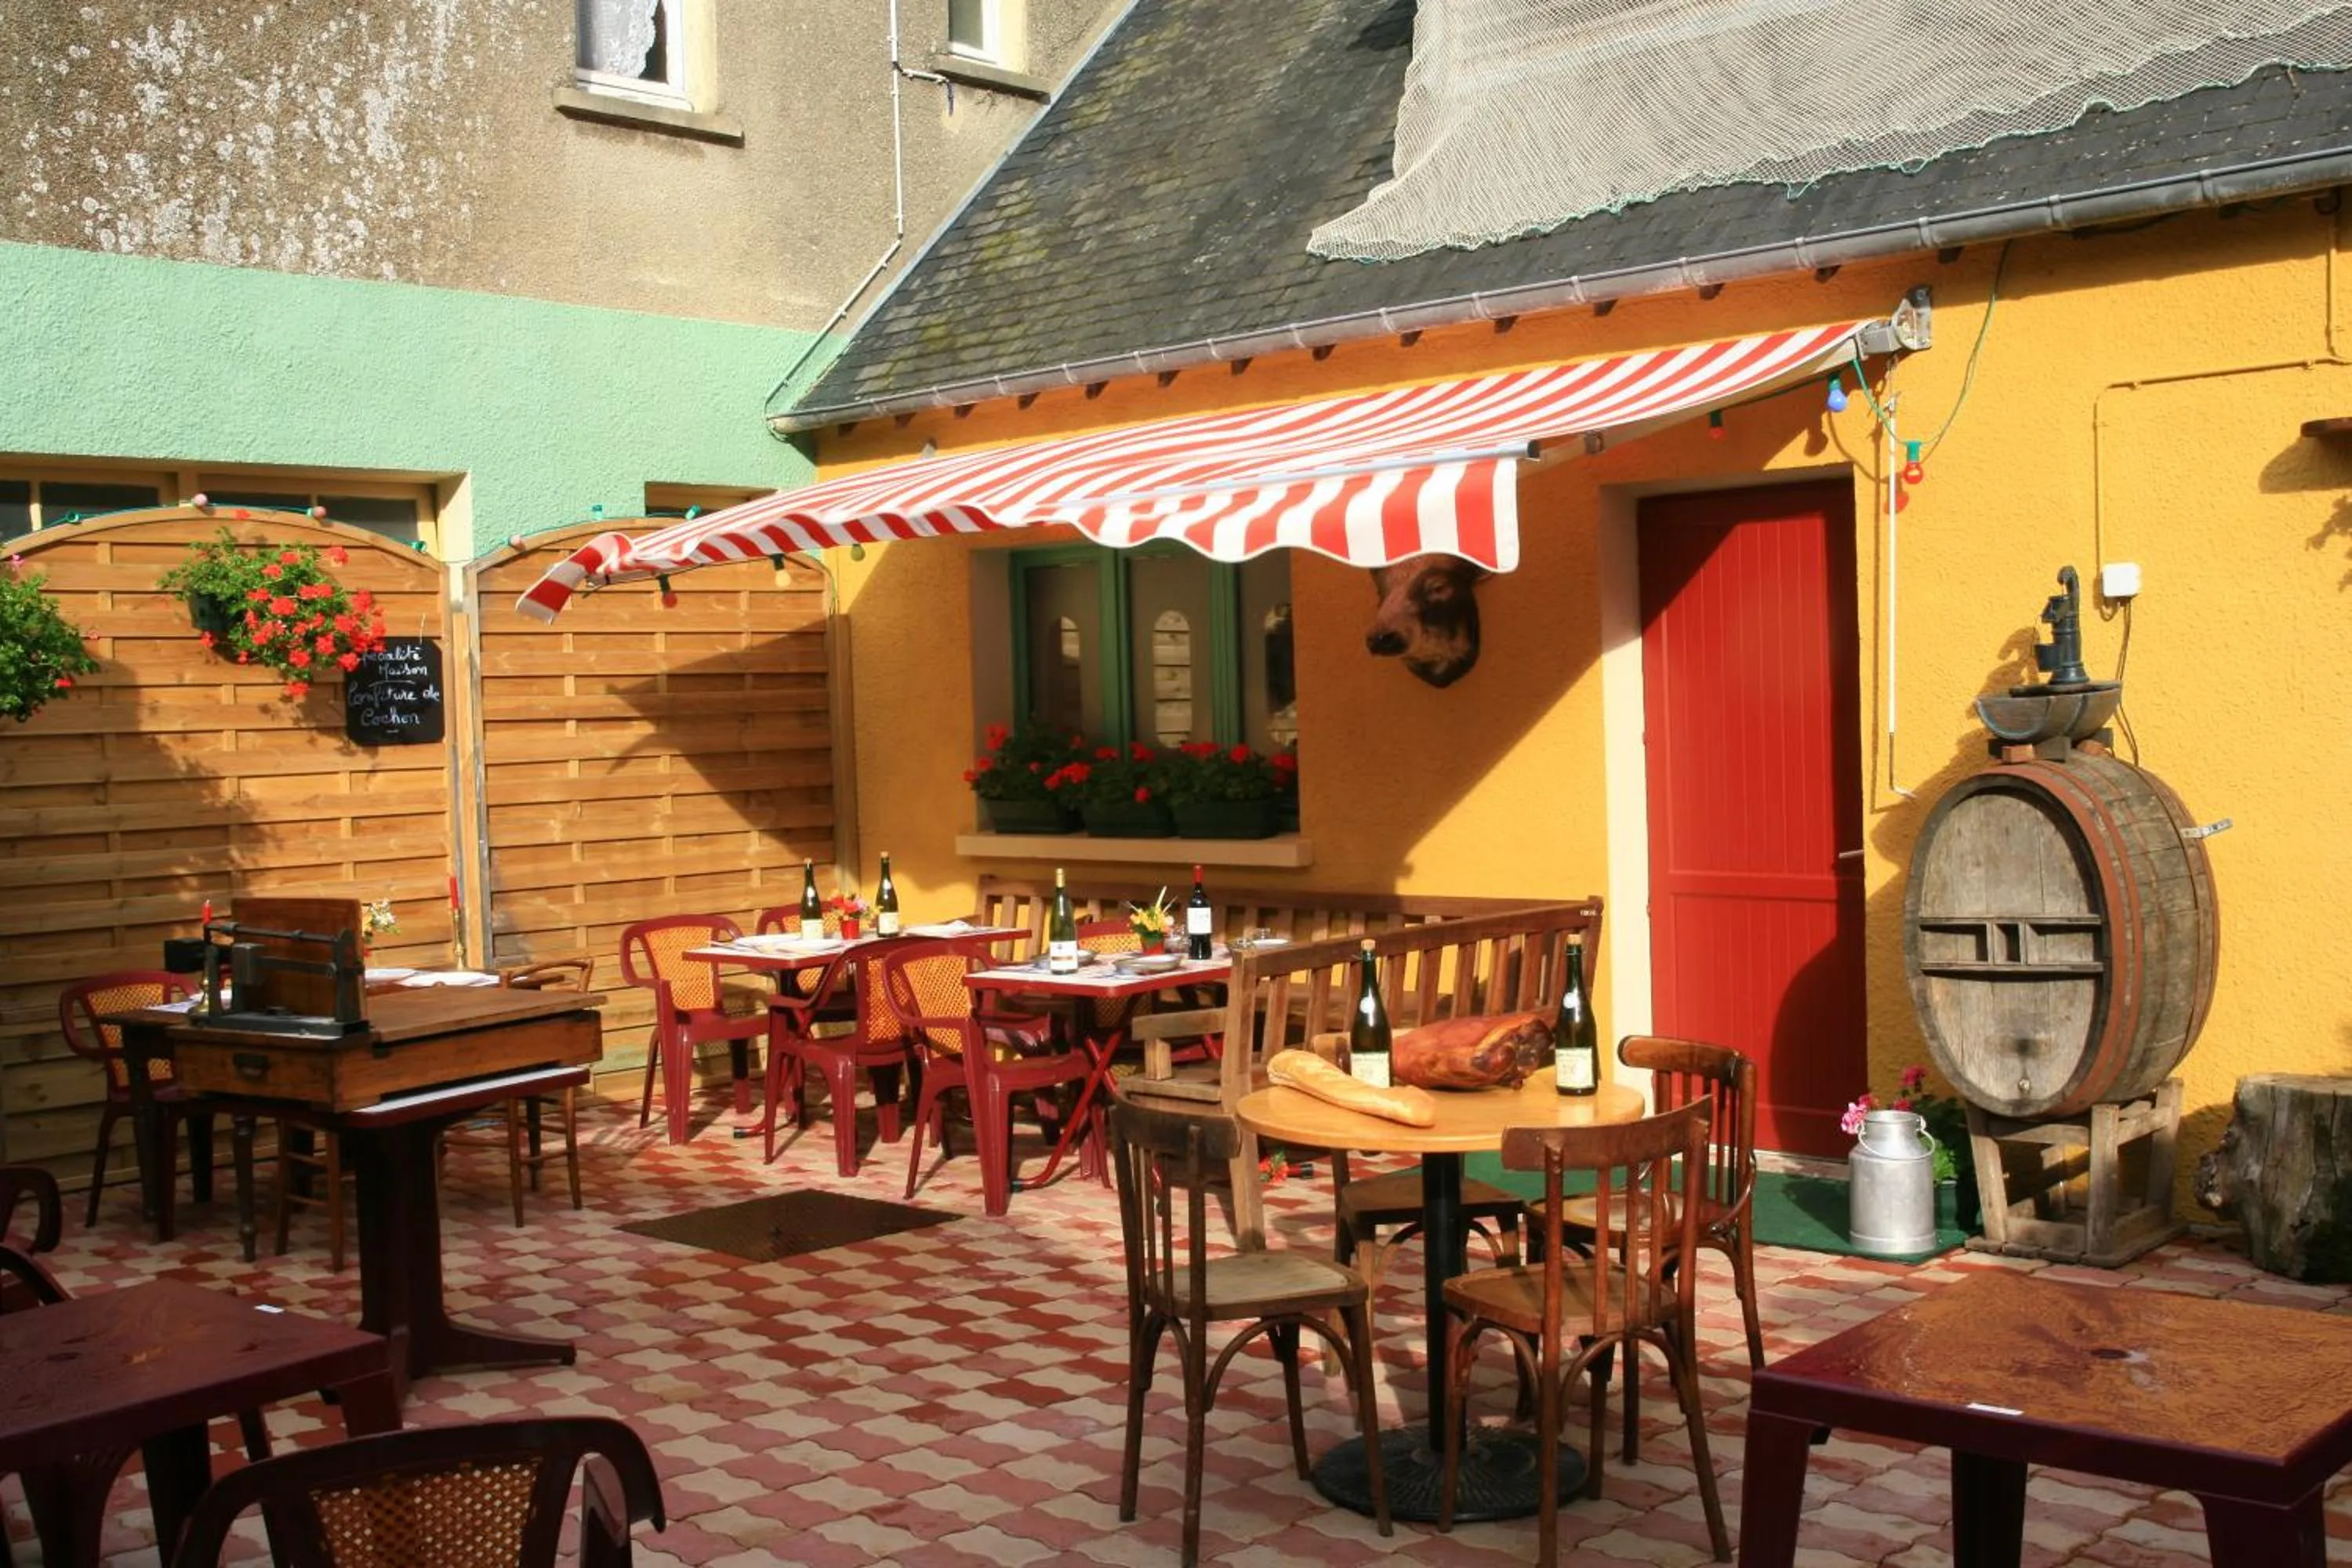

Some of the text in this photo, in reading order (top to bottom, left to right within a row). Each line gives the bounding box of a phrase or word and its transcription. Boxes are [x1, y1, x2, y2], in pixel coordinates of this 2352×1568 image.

[379, 662, 428, 680] Maison
[347, 681, 440, 708] Confiture de
[360, 705, 420, 727] Cochon
